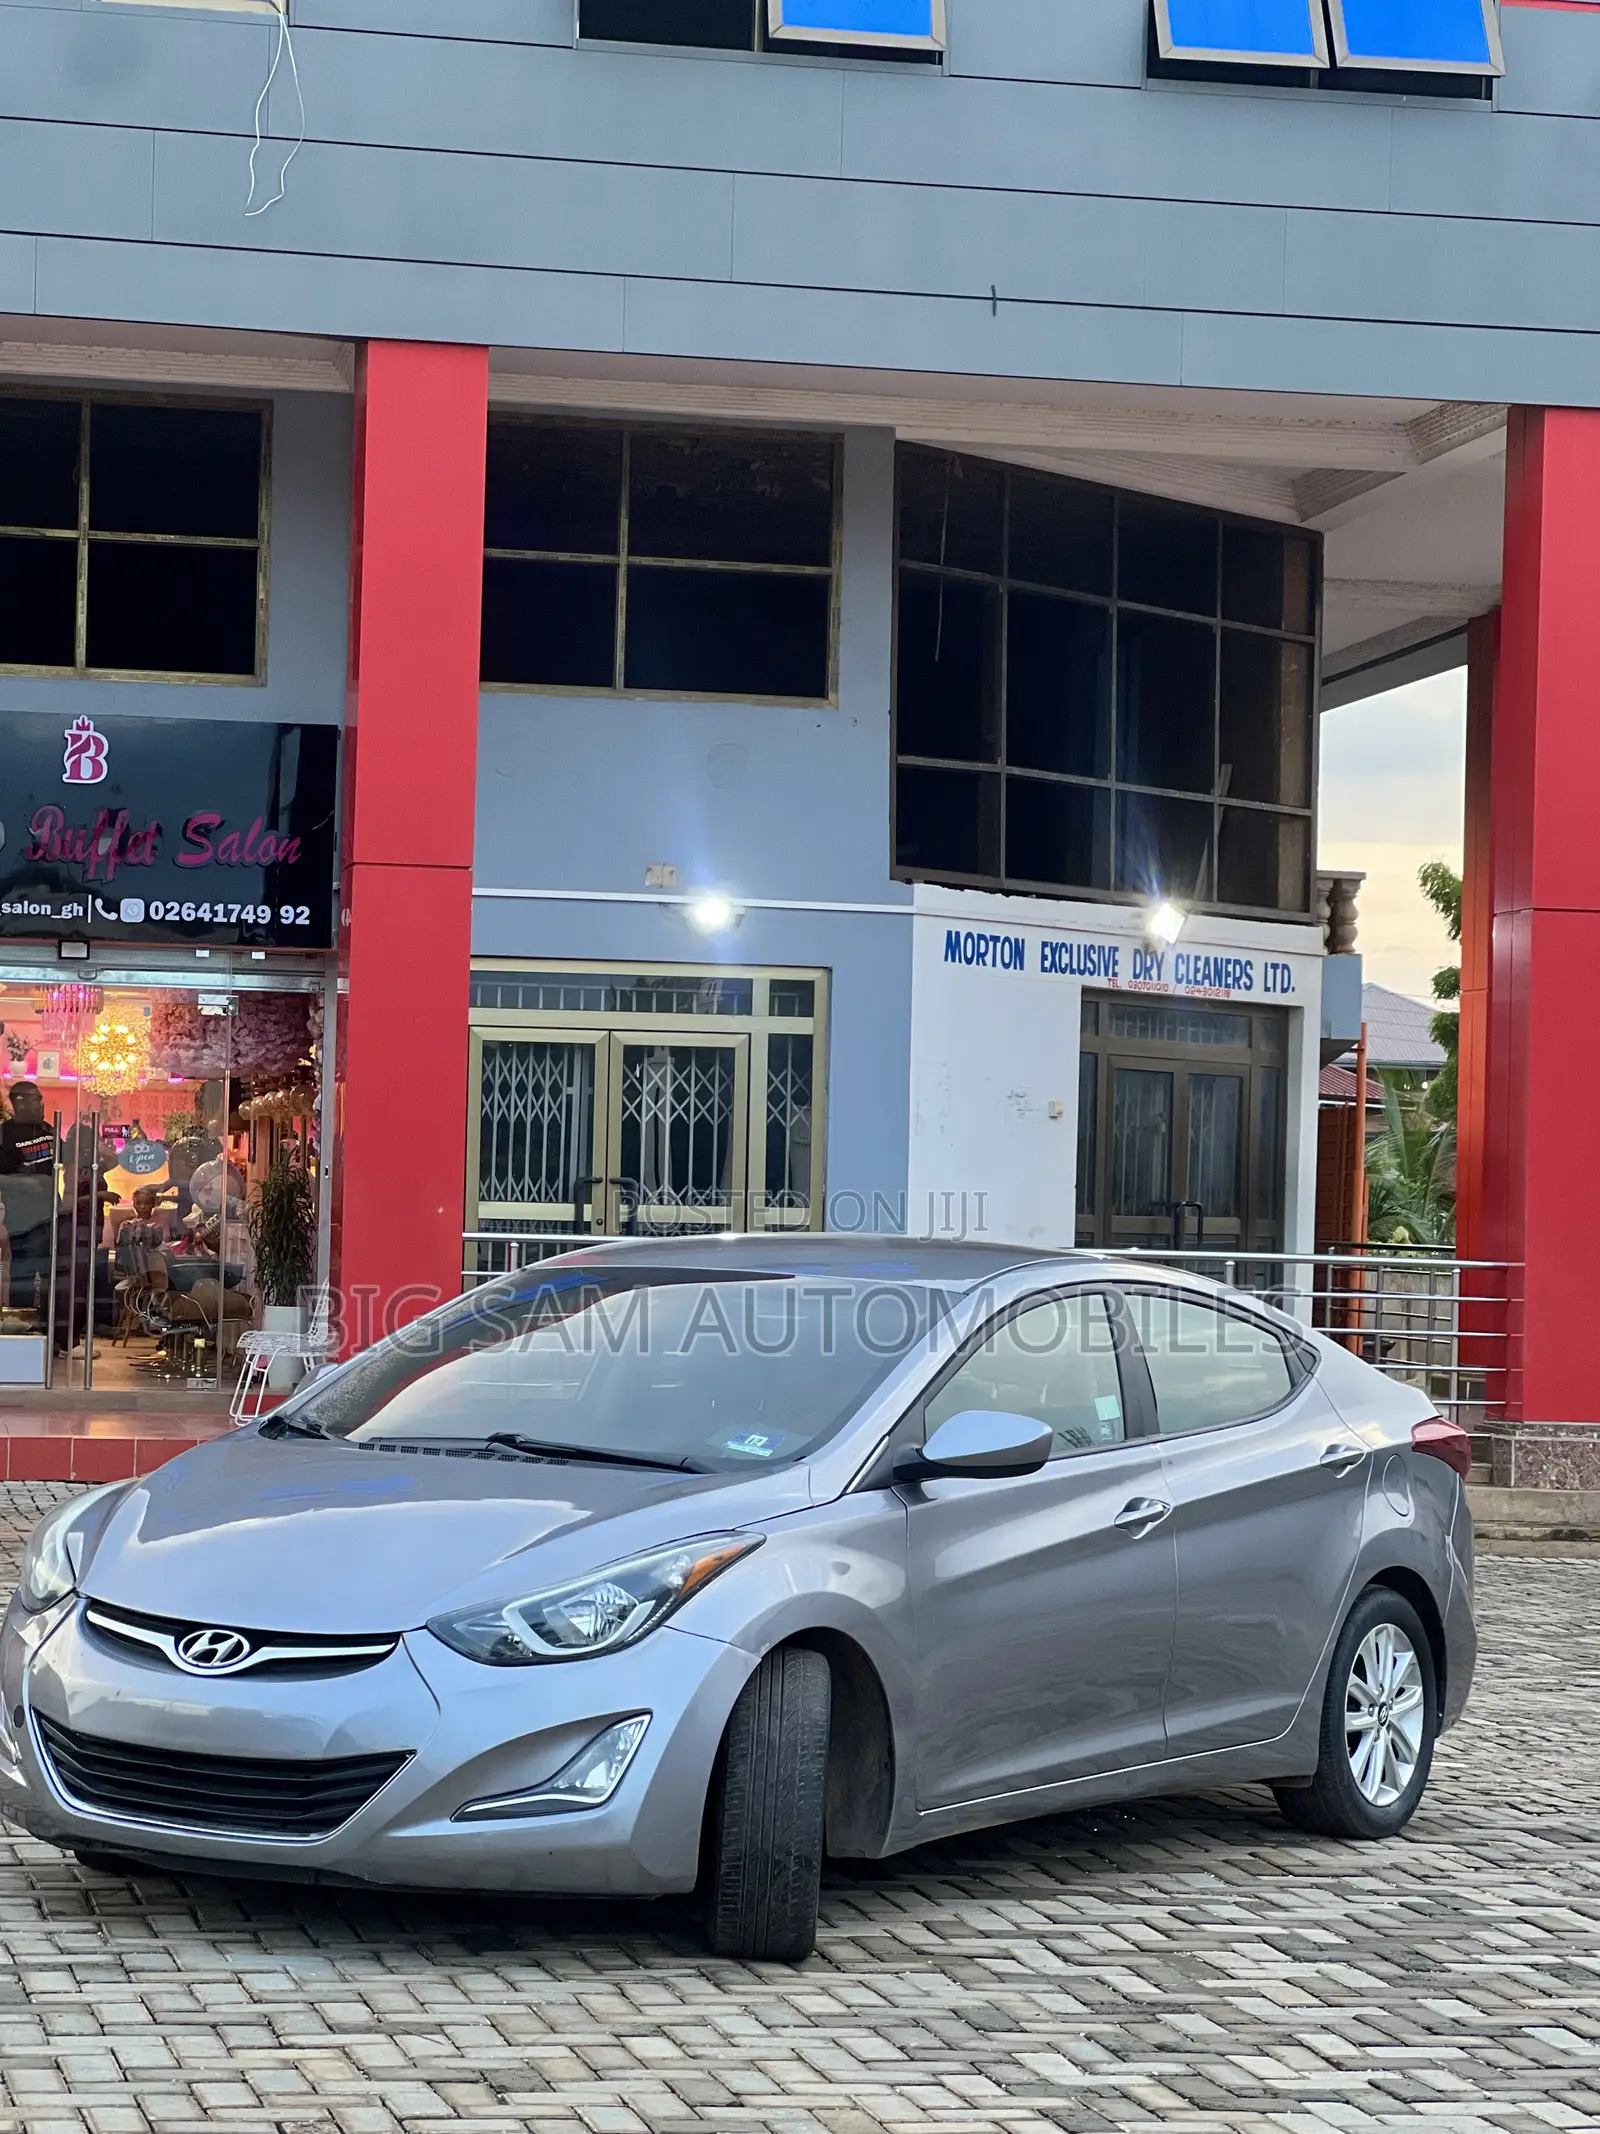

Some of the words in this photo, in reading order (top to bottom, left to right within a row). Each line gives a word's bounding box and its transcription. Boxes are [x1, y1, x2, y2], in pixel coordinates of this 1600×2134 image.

[174, 812, 302, 867] Salon
[0, 900, 84, 920] salon_gh
[280, 905, 311, 926] 92
[944, 929, 1025, 972] MORTON
[1040, 941, 1119, 978] EXCLUSIVE
[1132, 948, 1165, 981] DRY
[1175, 953, 1254, 992] CLEANERS
[1264, 962, 1296, 994] LTD.
[1107, 978, 1121, 989] TEL.
[129, 1153, 156, 1165] Open
